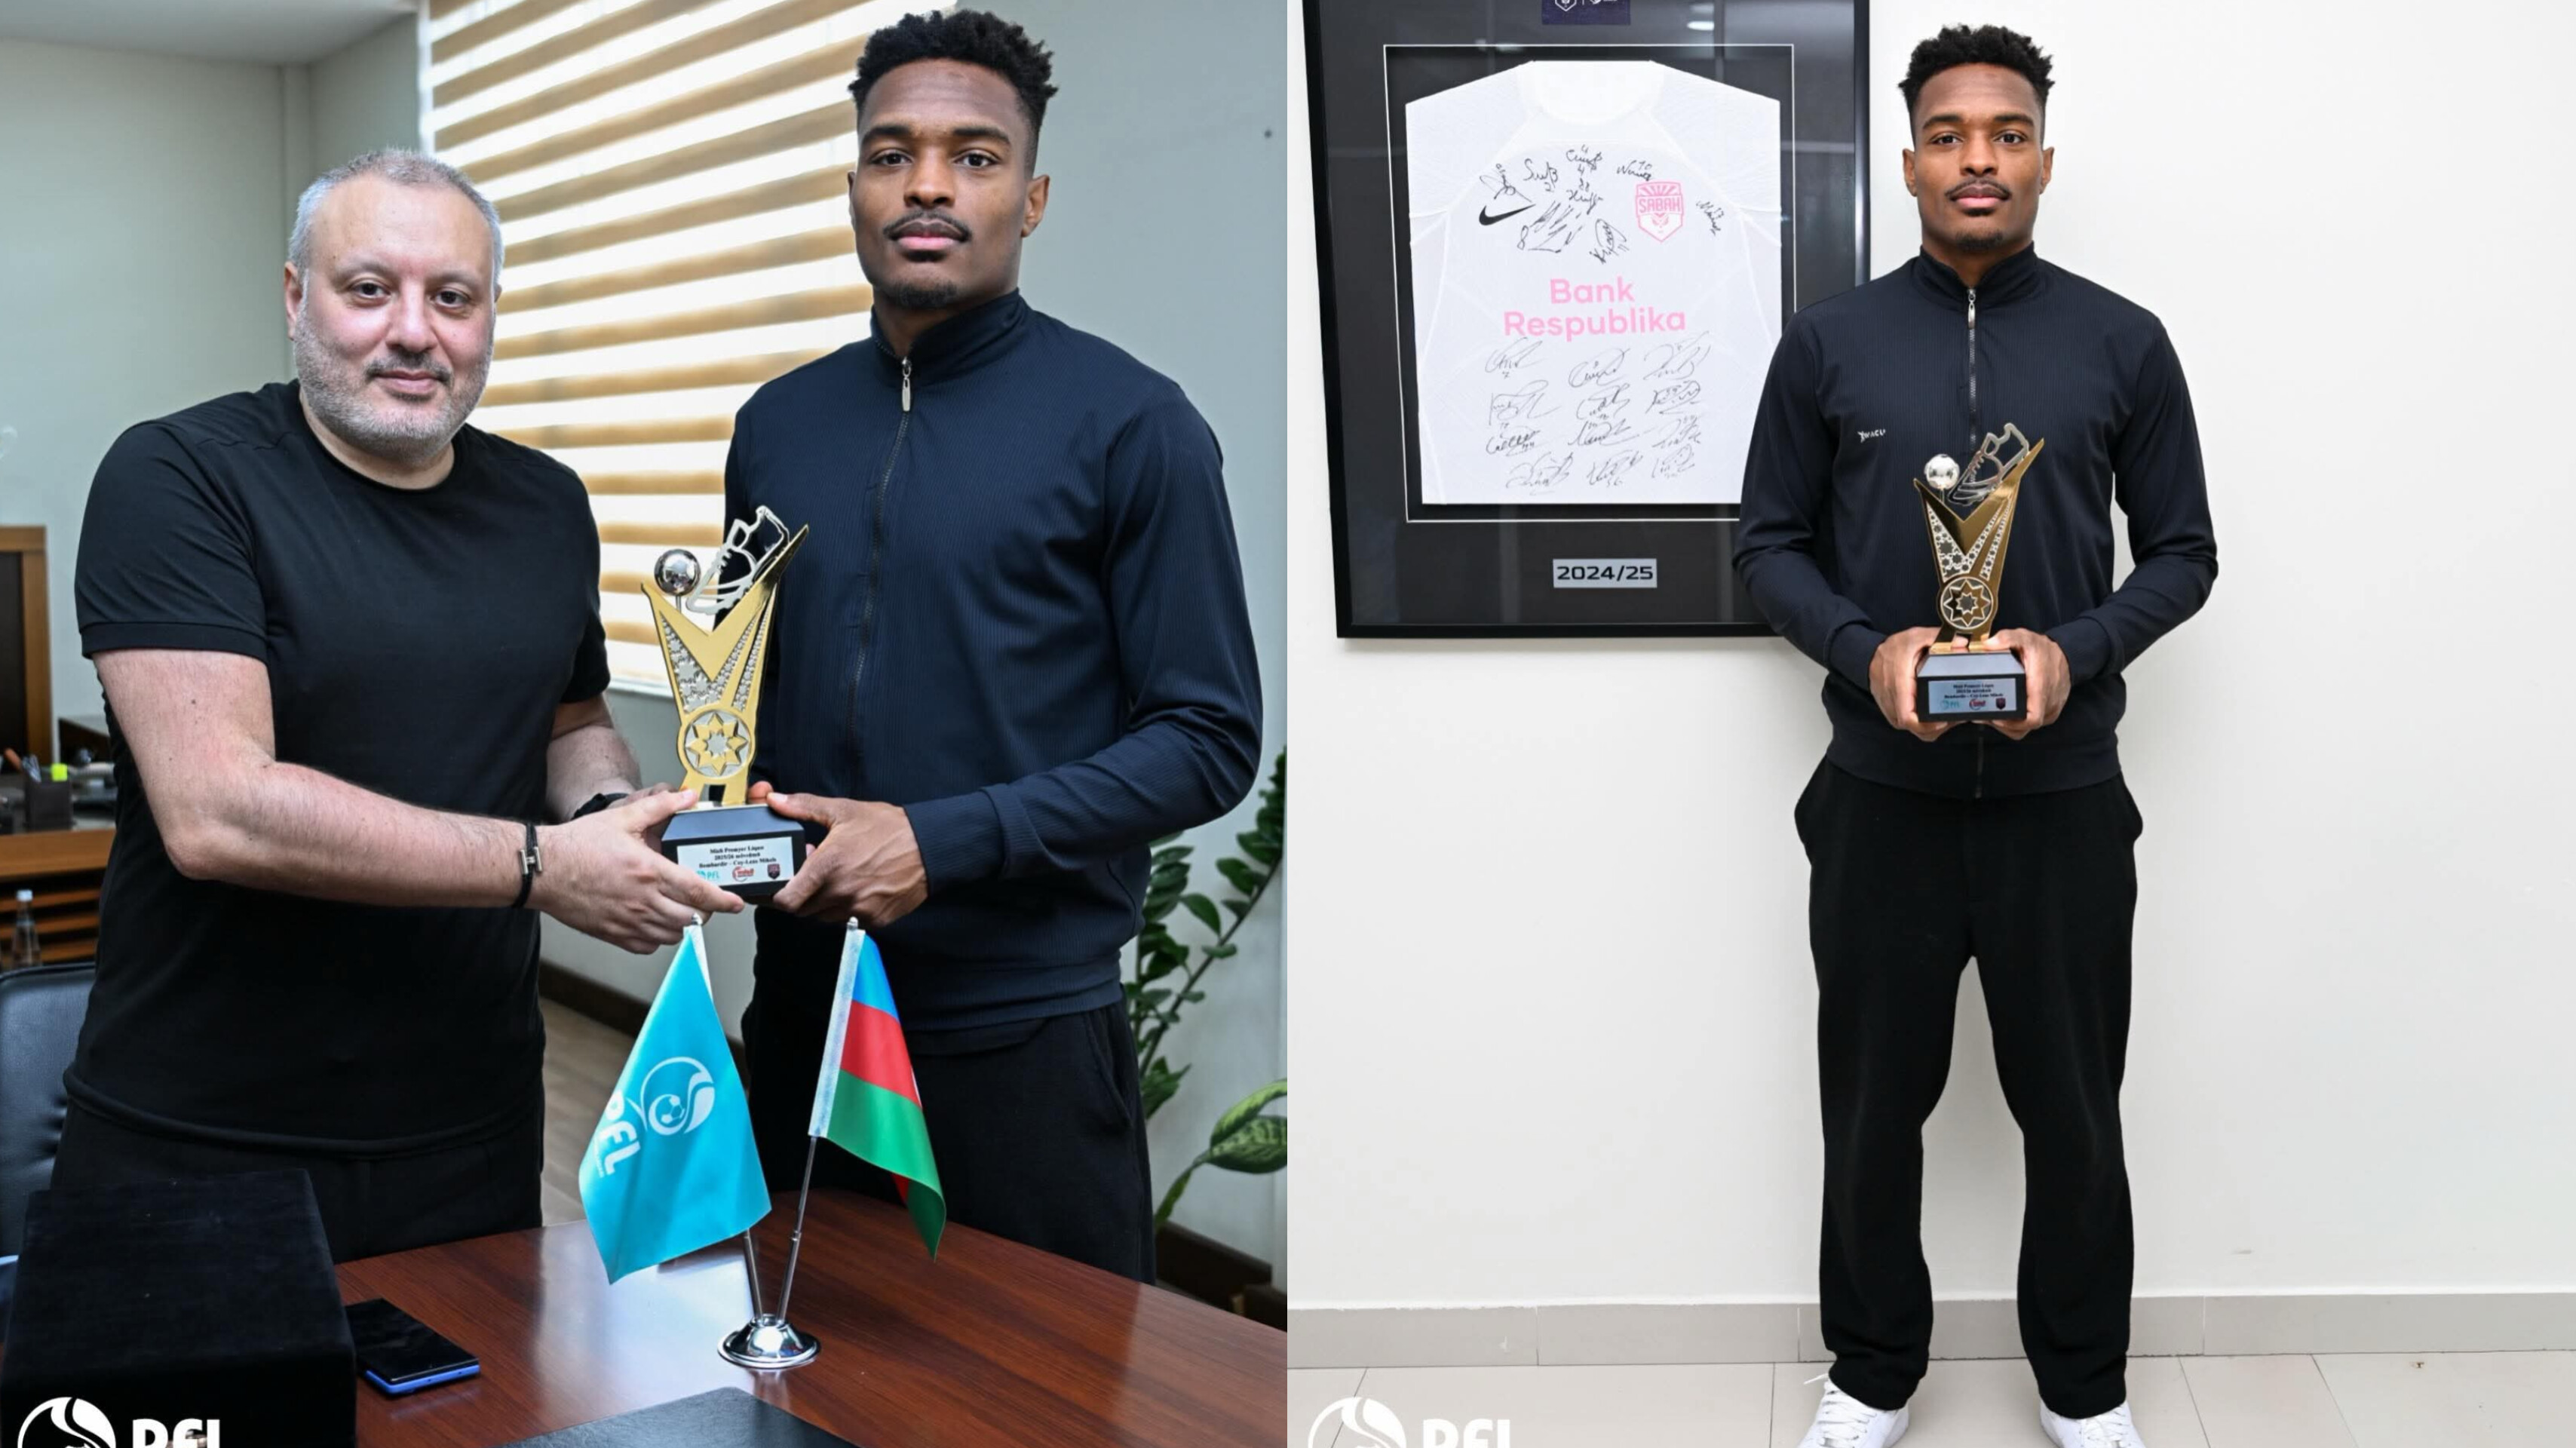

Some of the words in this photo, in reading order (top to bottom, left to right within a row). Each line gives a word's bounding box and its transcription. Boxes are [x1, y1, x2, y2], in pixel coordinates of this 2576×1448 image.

[1639, 196, 1681, 213] SABAH
[1550, 277, 1635, 304] Bank
[1503, 306, 1685, 342] Respublika
[1556, 565, 1654, 581] 2024/25
